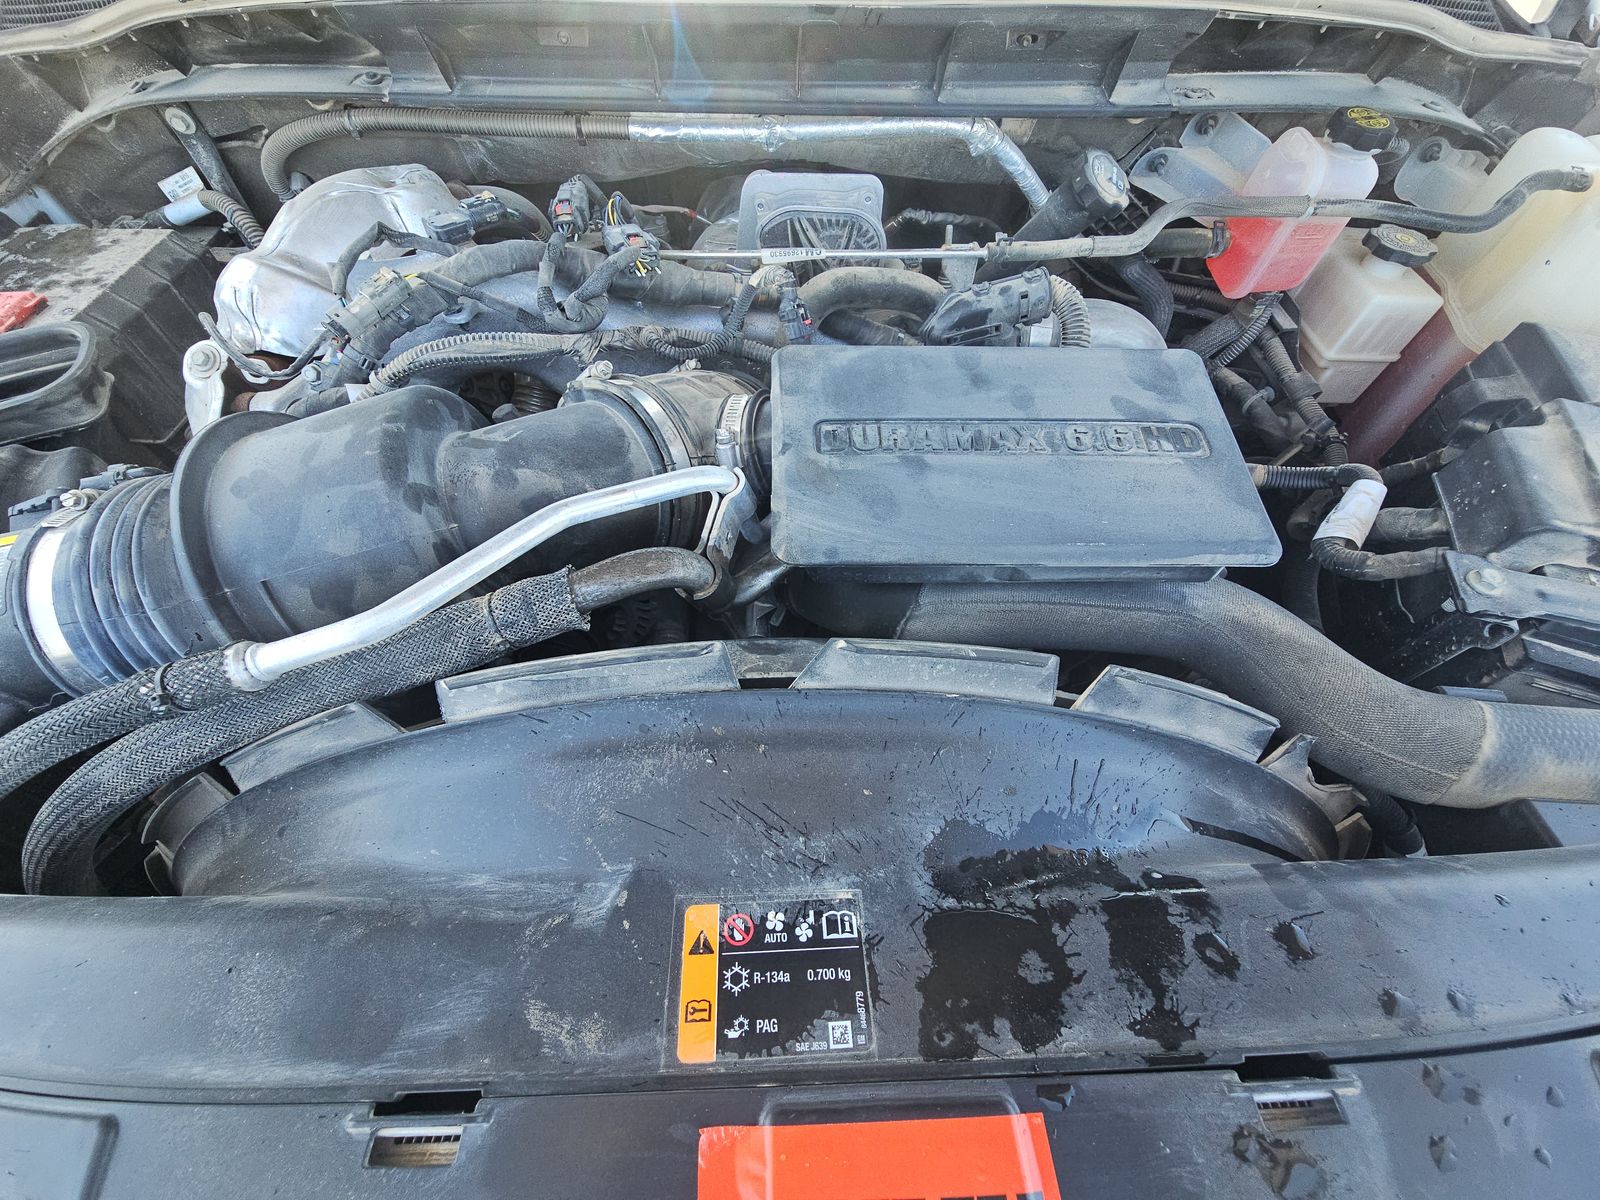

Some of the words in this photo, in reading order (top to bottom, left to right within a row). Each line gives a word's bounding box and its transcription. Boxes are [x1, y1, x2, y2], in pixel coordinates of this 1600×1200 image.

[820, 424, 1044, 453] DURAMAX
[764, 932, 788, 943] AUTO
[753, 971, 791, 984] R-134a
[807, 968, 836, 981] 0.700
[838, 967, 851, 981] kg
[756, 1019, 778, 1034] PAG
[795, 1043, 810, 1052] SAE
[811, 1041, 828, 1051] J639
